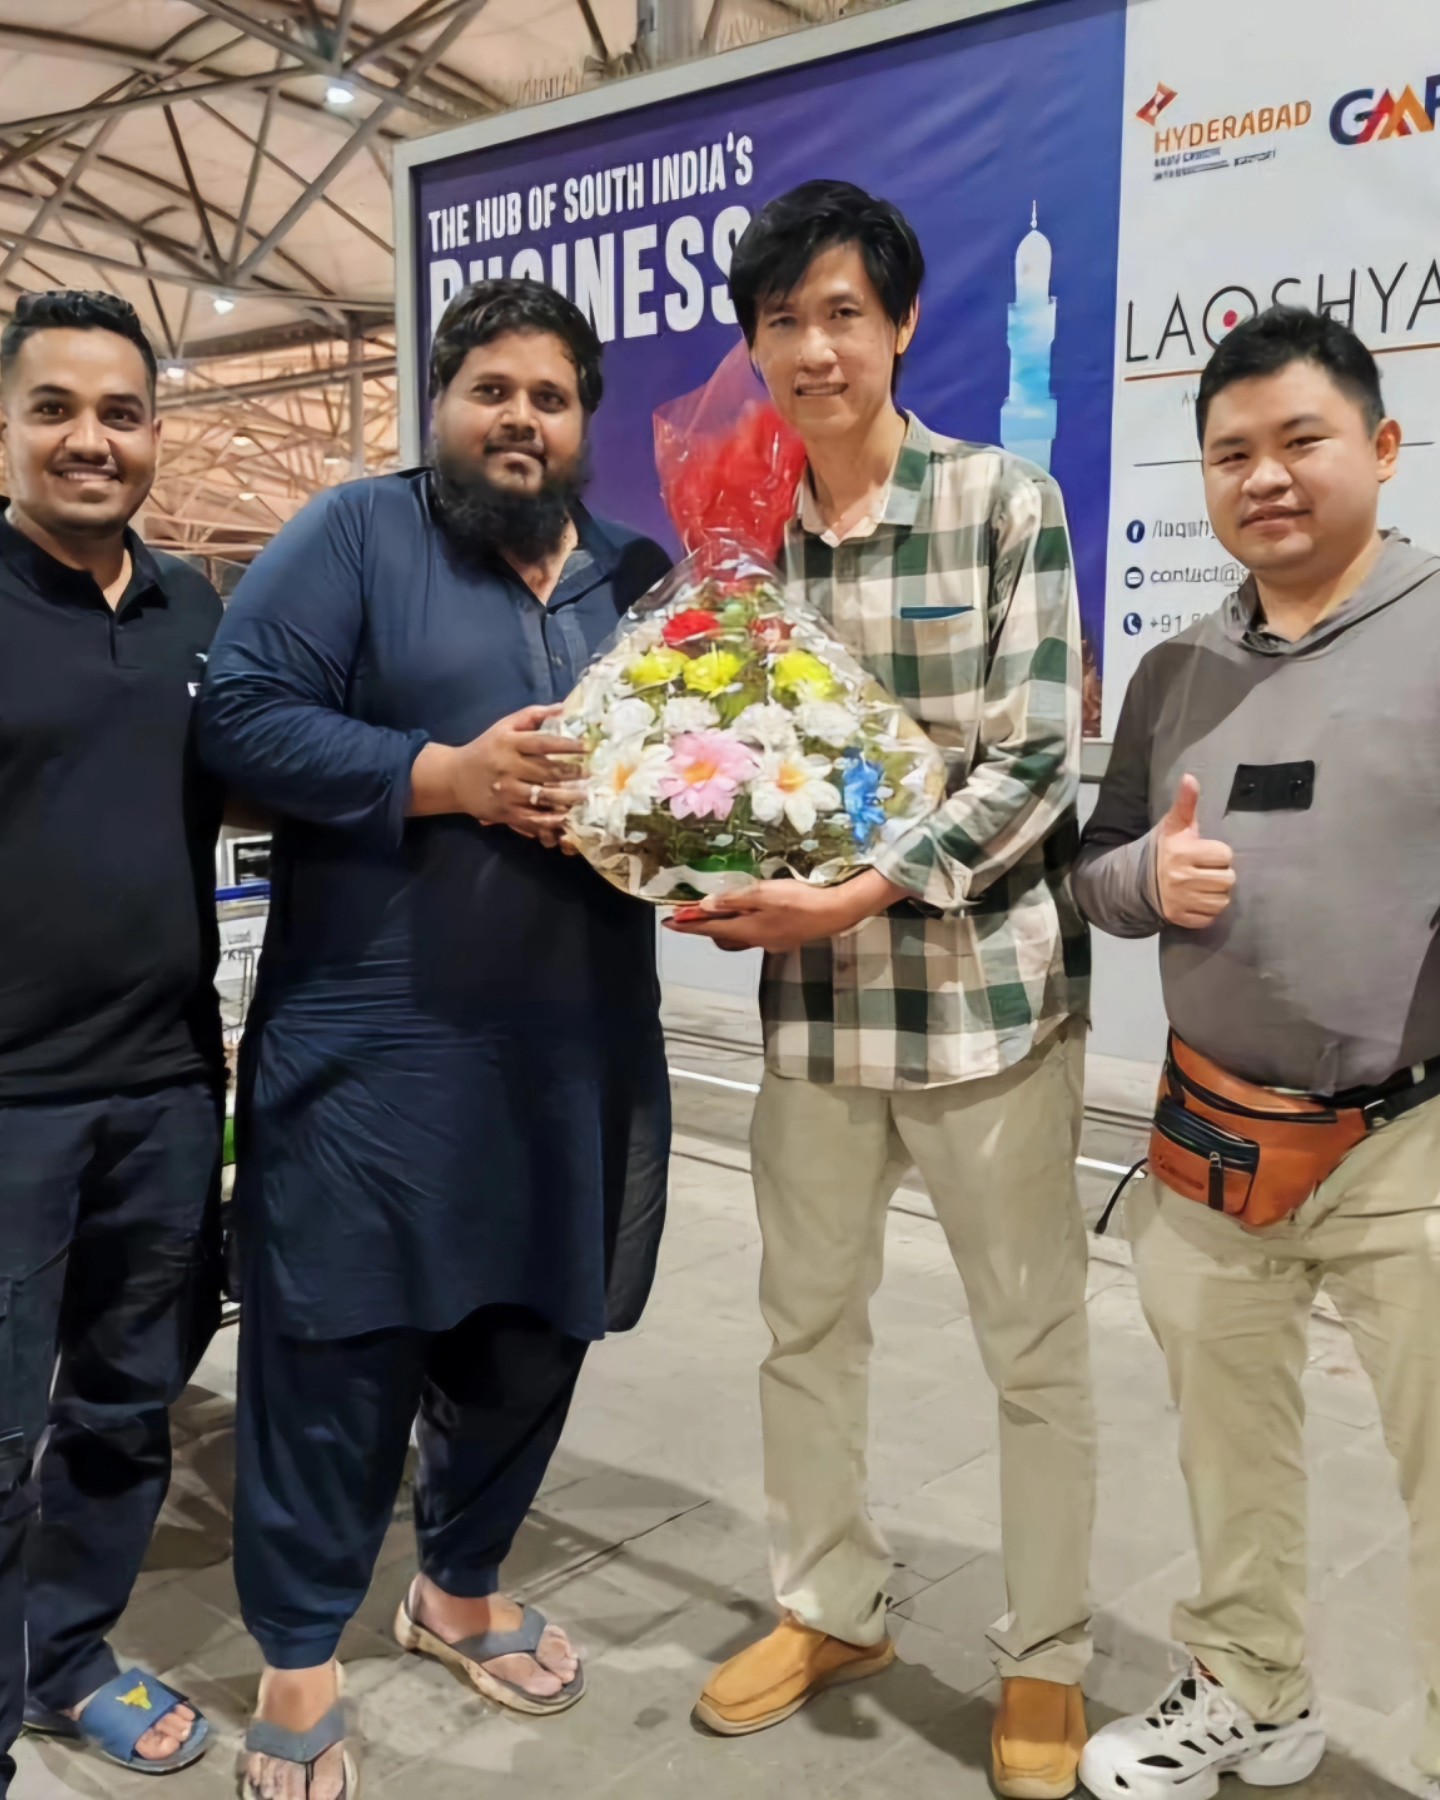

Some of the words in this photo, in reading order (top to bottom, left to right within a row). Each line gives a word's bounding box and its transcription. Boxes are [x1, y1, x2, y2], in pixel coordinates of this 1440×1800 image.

[1154, 100, 1312, 154] HYDERABAD
[428, 203, 470, 253] THE
[475, 192, 522, 243] HUB
[528, 183, 557, 231] OF
[564, 162, 645, 224] SOUTH
[652, 131, 754, 205] INDIA'S
[429, 206, 752, 344] BINESS
